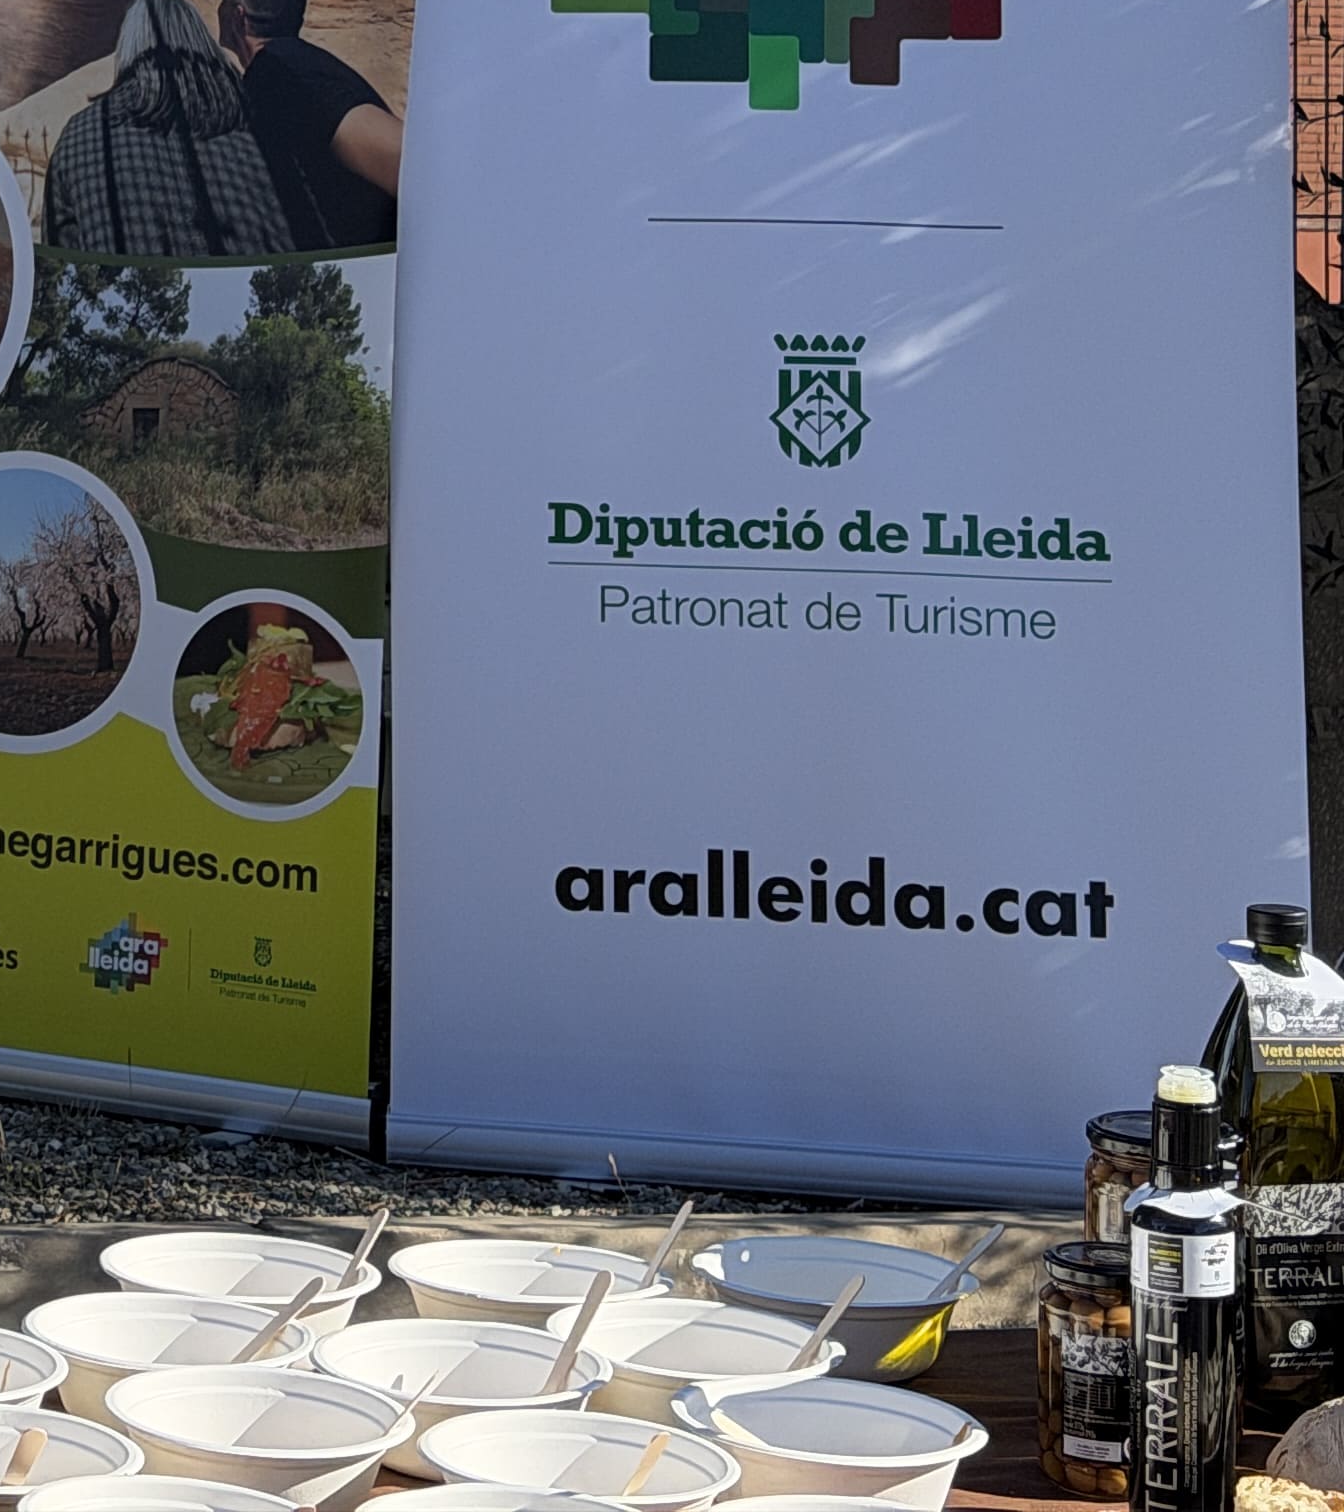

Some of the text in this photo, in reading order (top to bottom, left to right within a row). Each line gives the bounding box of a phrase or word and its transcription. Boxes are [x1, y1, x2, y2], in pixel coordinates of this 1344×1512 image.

[547, 502, 1111, 562] Diputació de Lleida
[599, 584, 1057, 640] Patronat de Turisme
[554, 848, 1115, 939] aralleida.cat
[118, 935, 159, 956] ara
[88, 946, 150, 976] lleida
[209, 968, 317, 992] Diputació de Lleida
[1258, 1043, 1293, 1058] Verd
[1255, 1243, 1268, 1256] Oli
[1269, 1242, 1298, 1255] d'Oliva
